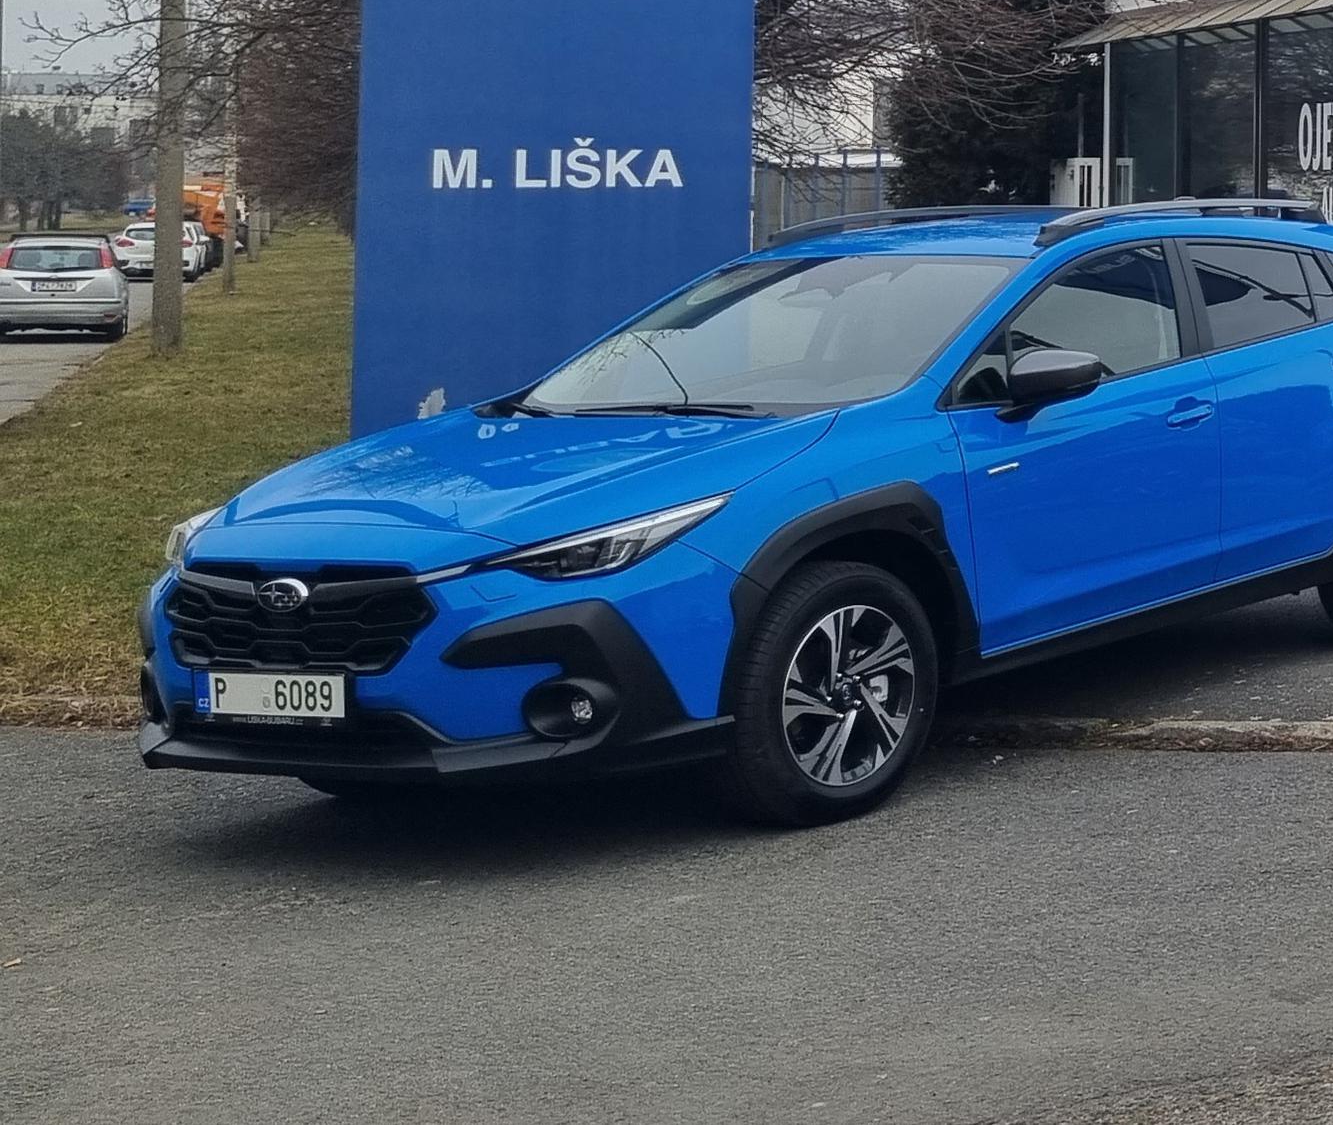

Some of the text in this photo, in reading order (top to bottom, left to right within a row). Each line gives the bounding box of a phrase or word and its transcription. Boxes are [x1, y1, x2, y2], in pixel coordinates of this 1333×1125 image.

[432, 136, 684, 189] M. LIŠKA
[198, 698, 210, 709] CZ
[214, 677, 333, 712] P 6089
